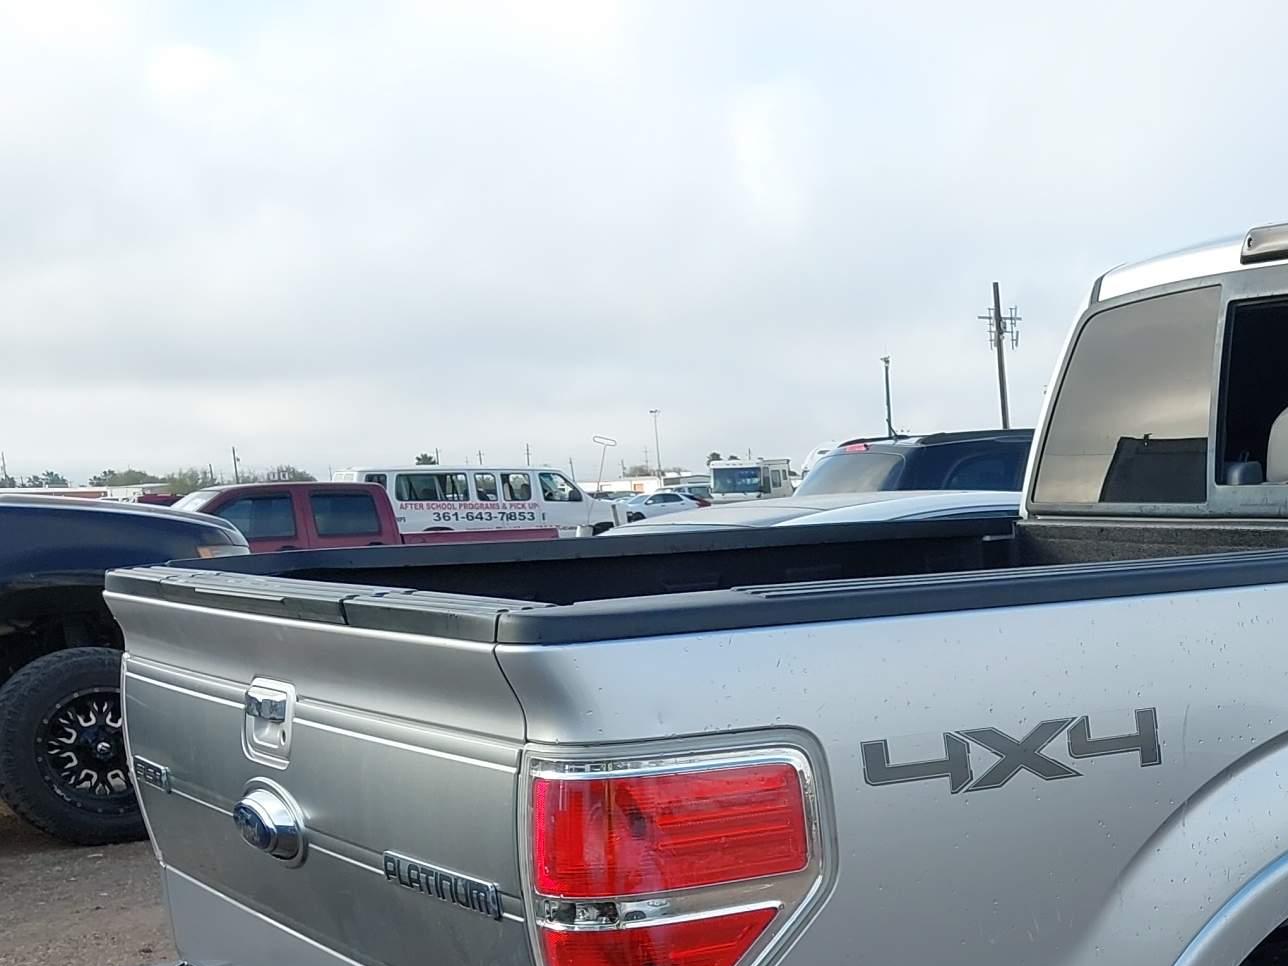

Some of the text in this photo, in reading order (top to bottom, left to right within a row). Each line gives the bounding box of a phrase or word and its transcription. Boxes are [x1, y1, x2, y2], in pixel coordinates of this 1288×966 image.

[399, 503, 424, 511] AFTER
[426, 503, 457, 511] SCHOOL
[459, 503, 501, 511] PROGRAMS
[510, 503, 528, 511] PICK
[432, 511, 536, 522] 361-643-7853
[383, 853, 493, 917] PLATINUM
